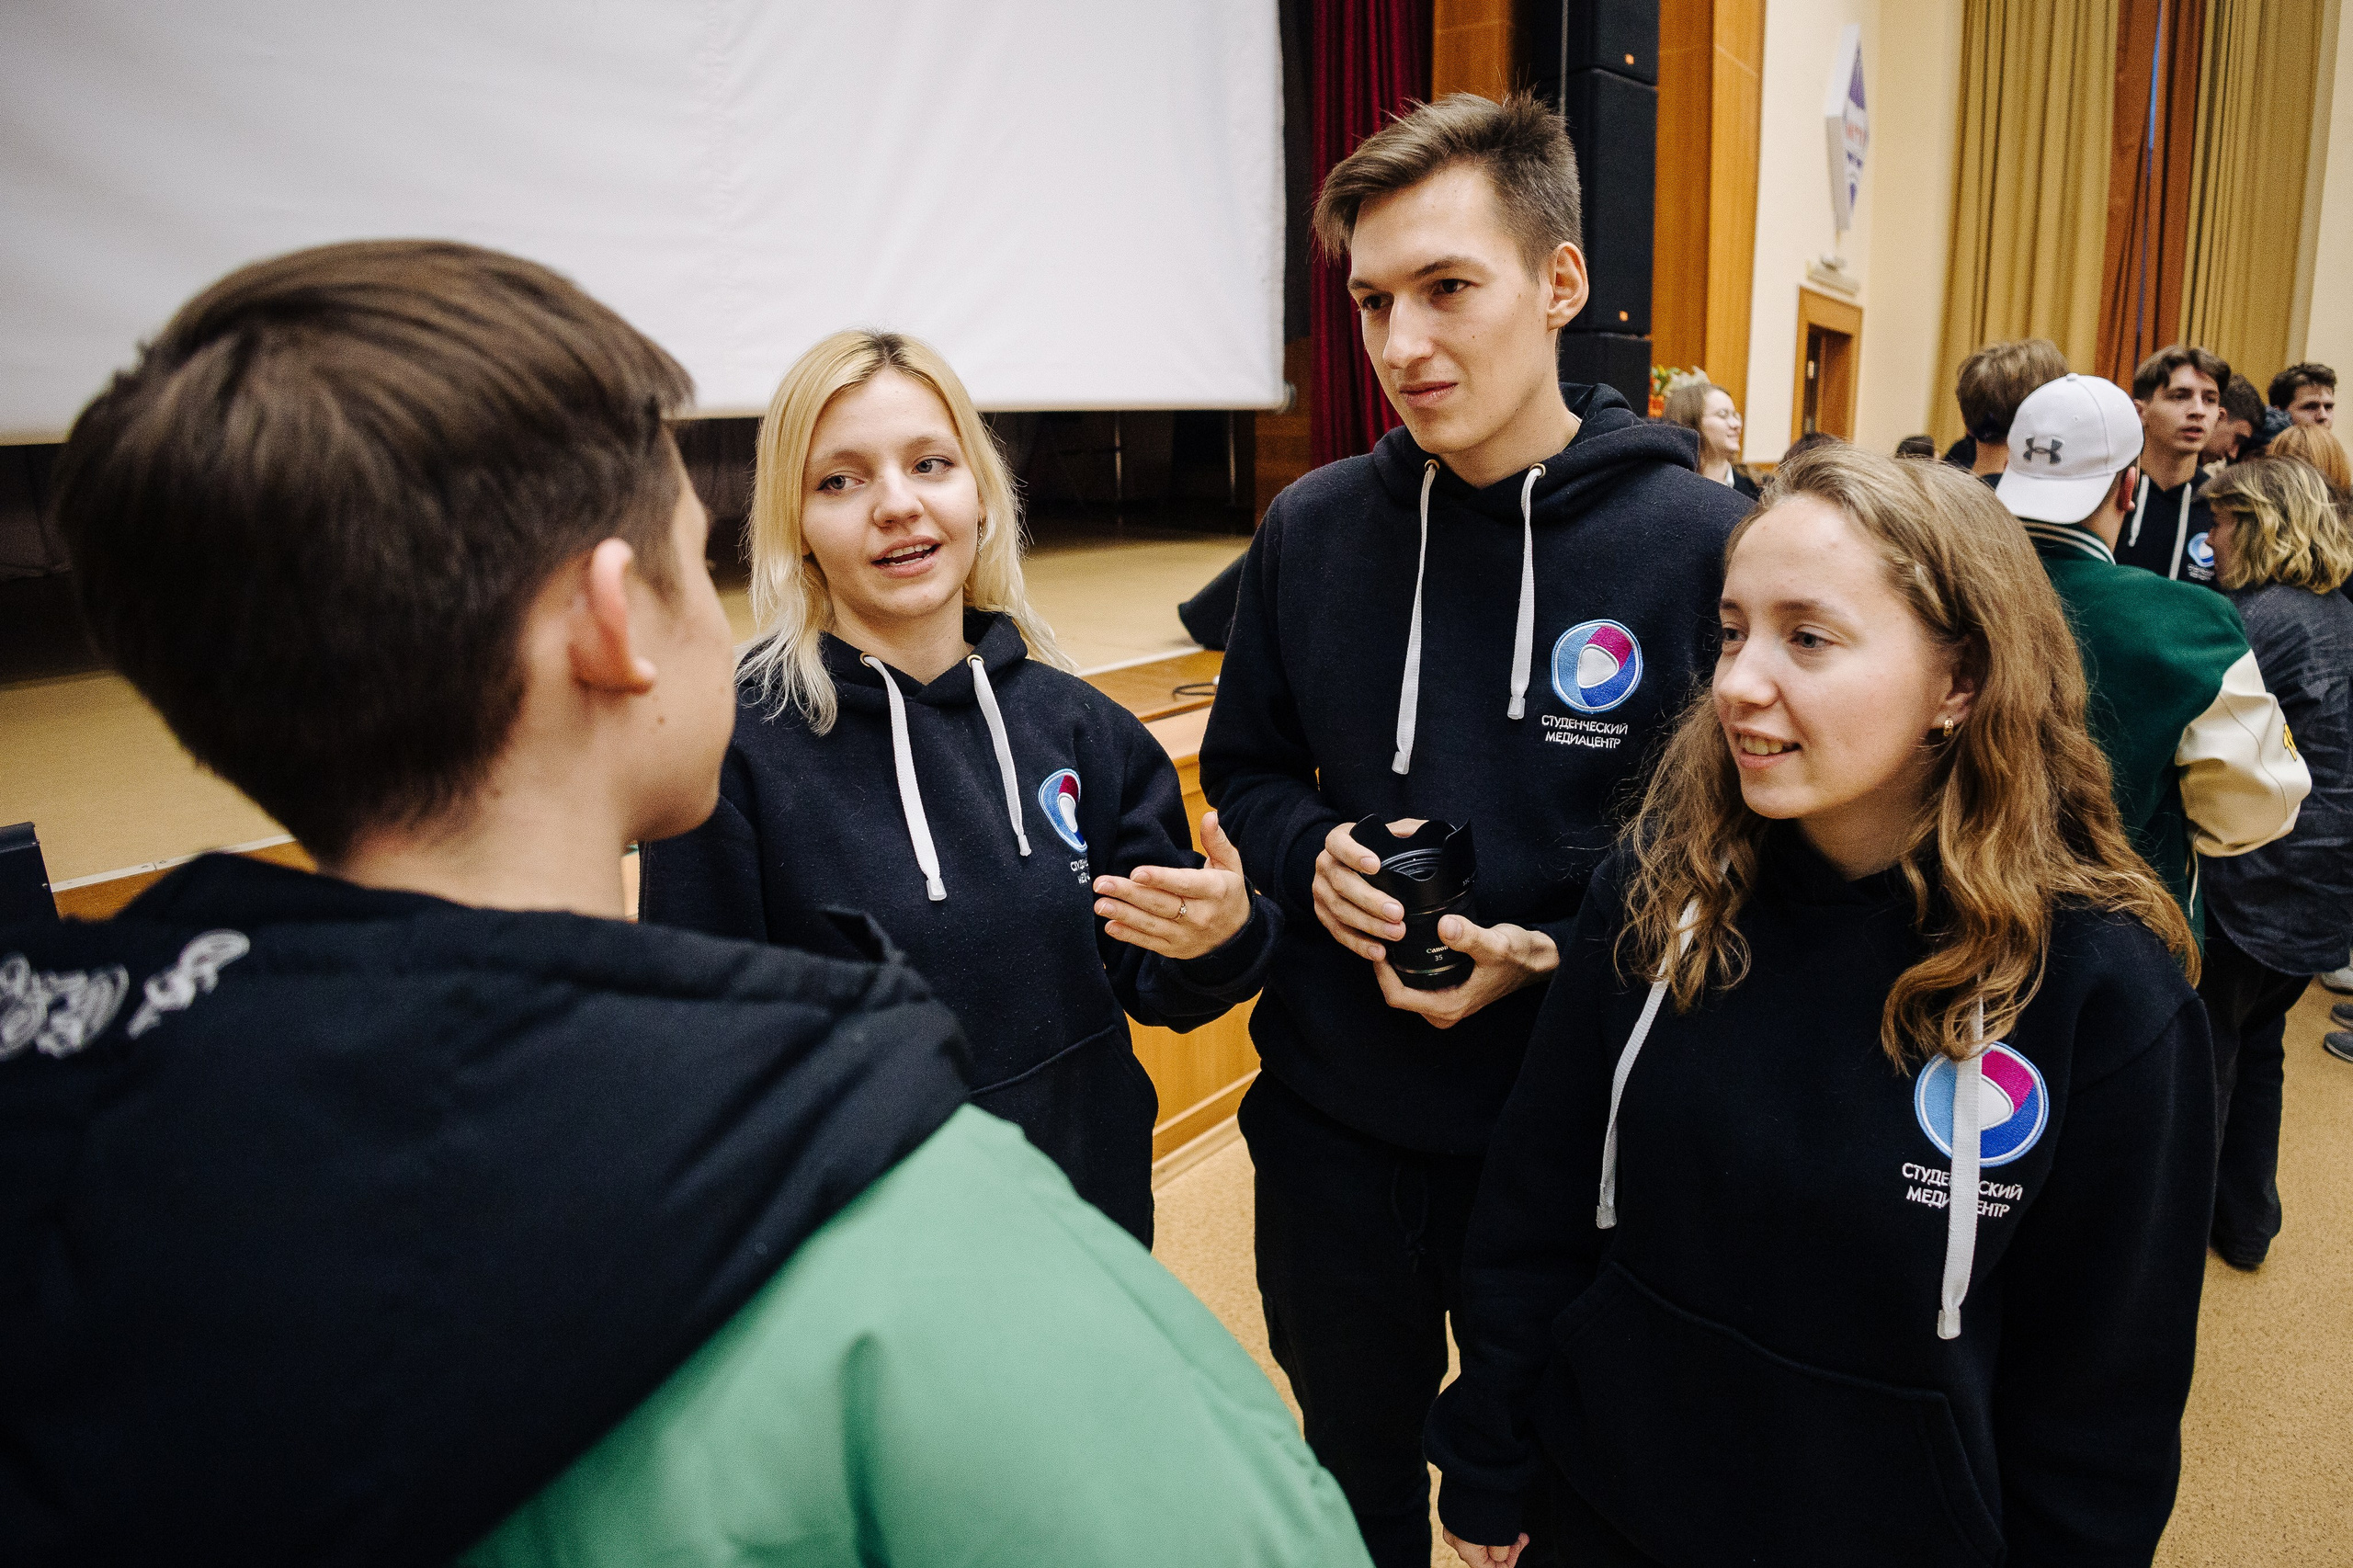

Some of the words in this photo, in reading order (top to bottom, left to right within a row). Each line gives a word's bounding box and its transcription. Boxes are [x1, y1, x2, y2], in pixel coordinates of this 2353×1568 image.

[1541, 714, 1629, 735] СТУДЕНЧЕСКИЙ
[1545, 731, 1621, 749] МЕДИАЦЕНТР
[1426, 946, 1449, 954] Canon
[1902, 1162, 2023, 1200] СТУДЕСКИЙ
[1905, 1185, 2010, 1218] МЕДИЕНТР
